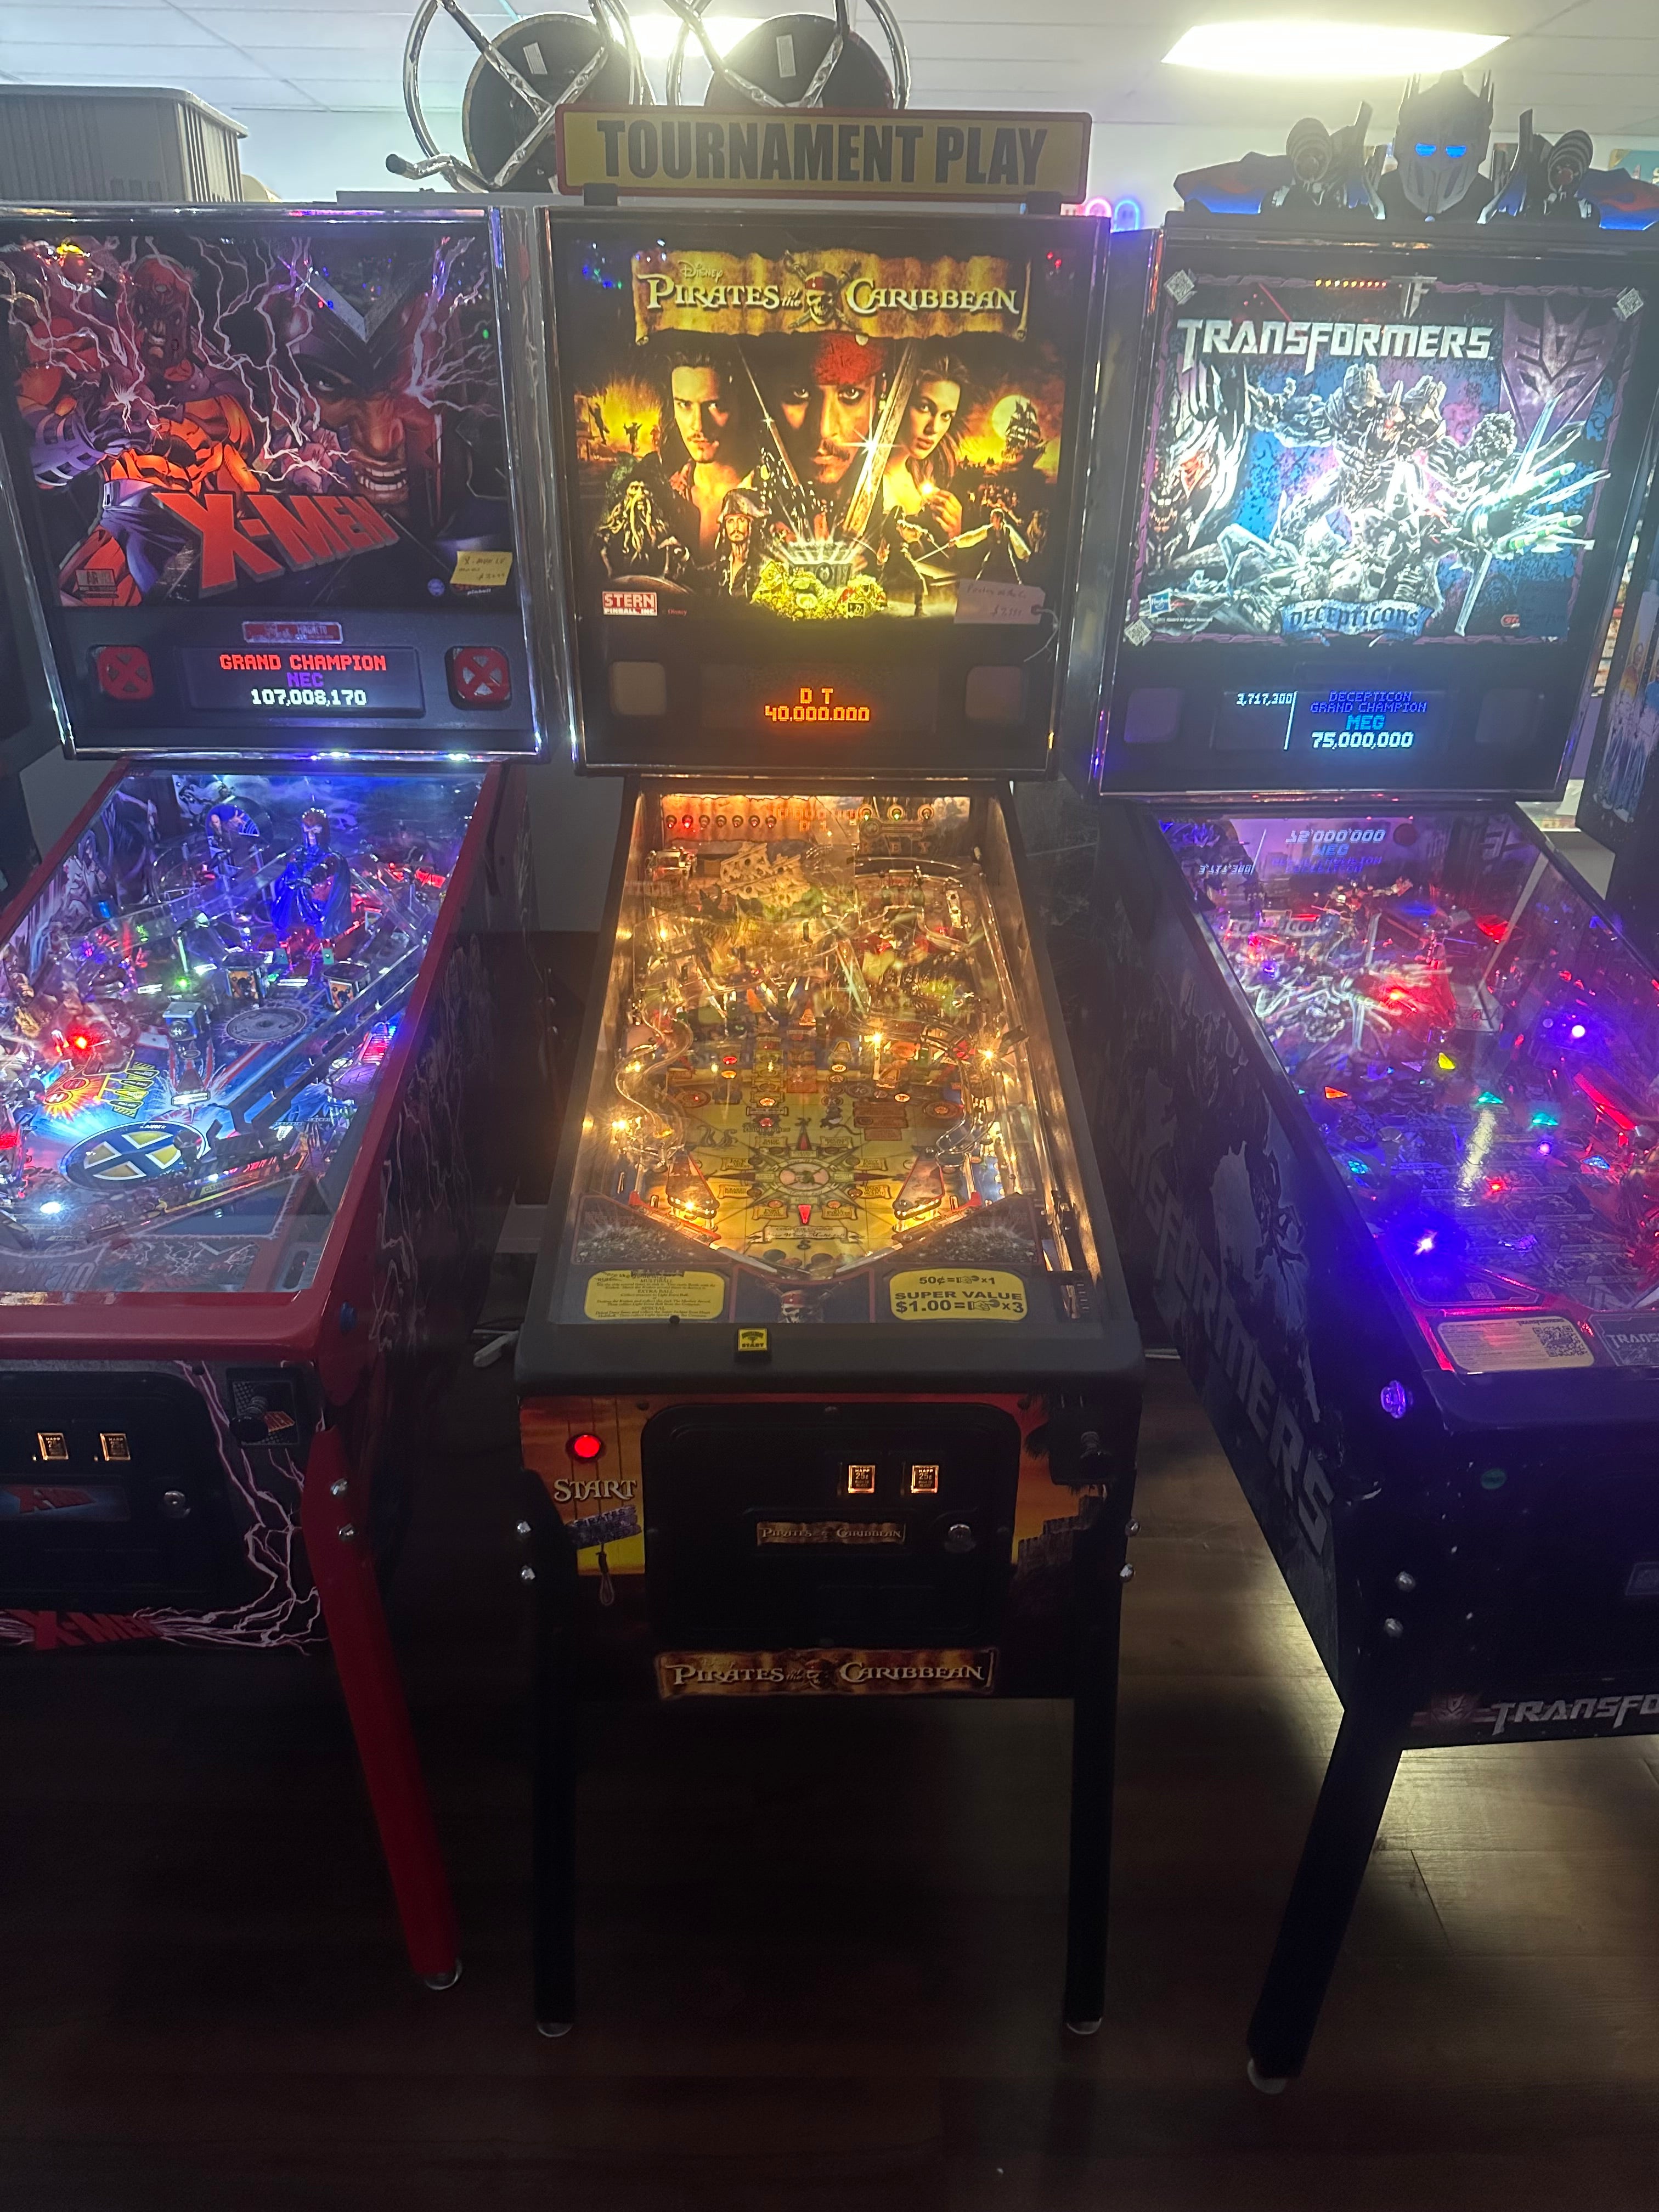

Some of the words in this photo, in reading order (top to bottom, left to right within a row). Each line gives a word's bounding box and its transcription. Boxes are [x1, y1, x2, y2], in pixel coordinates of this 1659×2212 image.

[596, 120, 923, 183] TOURNAMENT
[935, 126, 1047, 185] PLAY
[636, 273, 781, 311] PIRATES
[845, 278, 1020, 315] CARIBBEAN
[1177, 318, 1493, 376] TRANSFORMERS
[150, 492, 400, 595] X-MEN
[604, 594, 655, 608] STERN
[219, 654, 282, 670] GRAND
[289, 654, 387, 671] CHAMPION
[286, 672, 324, 687] NEC
[251, 689, 367, 706] 107,008,170
[800, 687, 812, 704] D
[821, 688, 833, 704] T
[1236, 692, 1293, 706] 3,717,300
[1328, 690, 1413, 703] DECEPTICON
[1310, 702, 1353, 713] GRAND
[1358, 702, 1427, 713] CHAMPION
[1346, 714, 1386, 730] MEG
[1311, 731, 1414, 749] 75,000,000
[895, 1291, 957, 1300] SUPER
[962, 1291, 1023, 1301] VALUE
[554, 1479, 637, 1503] START
[3, 1608, 163, 1651] X-MEN
[665, 1664, 784, 1685] PIRATES
[839, 1662, 985, 1685] CARIBBEAN
